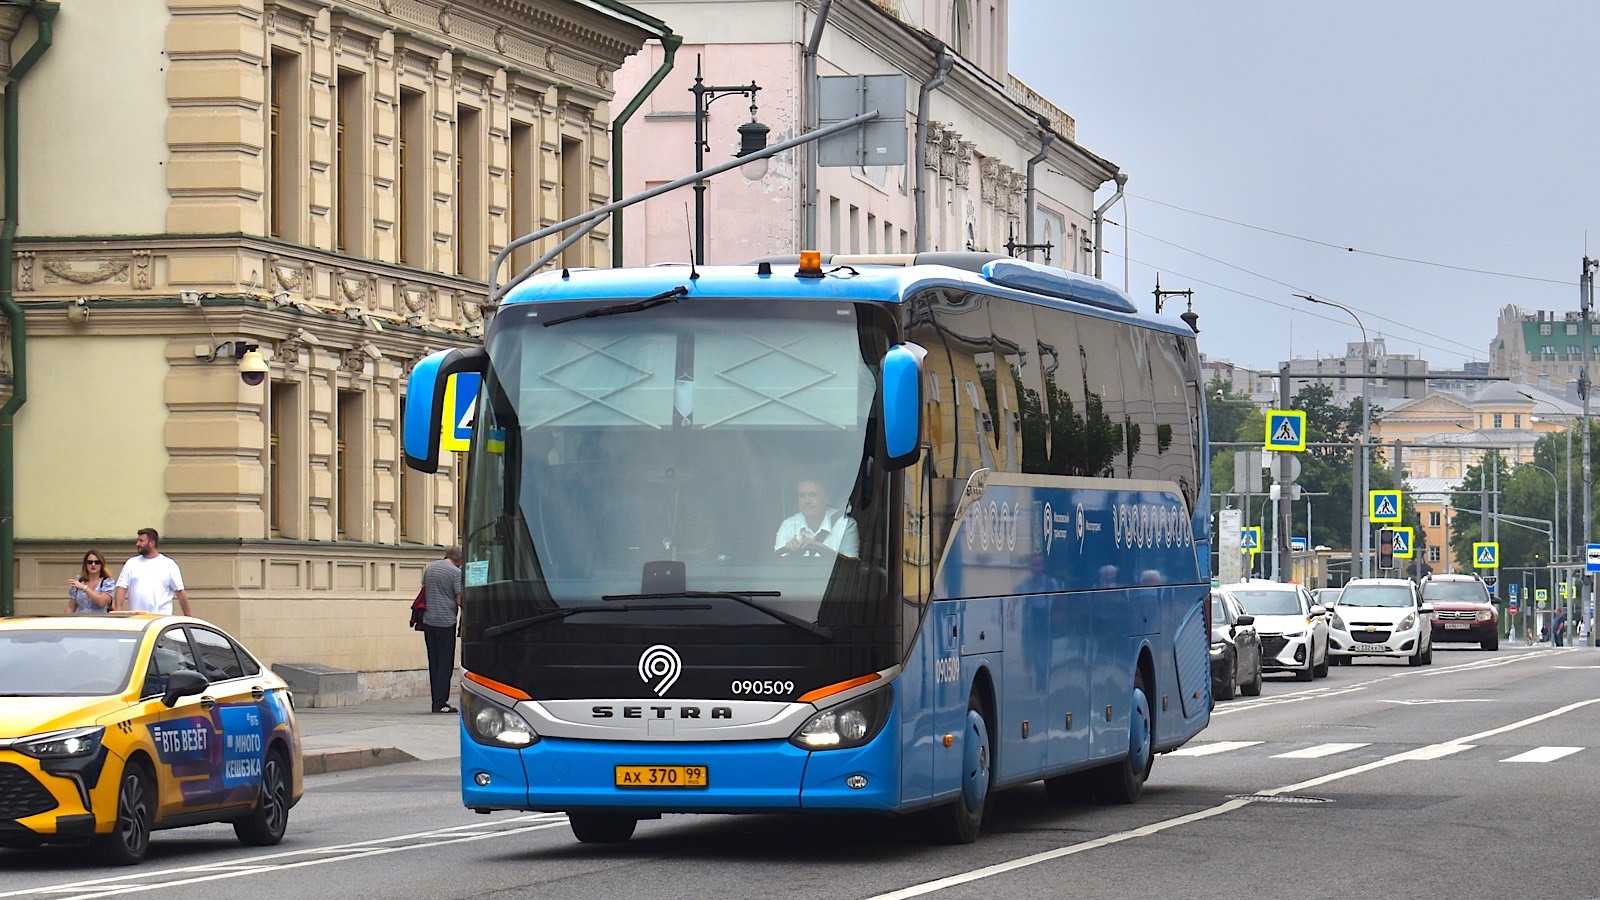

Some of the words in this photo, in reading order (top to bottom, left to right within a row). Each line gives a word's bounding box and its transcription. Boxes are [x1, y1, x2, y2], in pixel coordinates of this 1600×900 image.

[936, 656, 960, 683] 090509
[731, 680, 795, 695] 090509
[592, 706, 733, 719] SETRA
[162, 730, 180, 752] ВТБ
[181, 723, 207, 752] ВЕЗЁТ
[235, 733, 261, 753] МНОГО
[225, 758, 262, 779] КЕШБЭКА
[648, 768, 677, 783] 370
[686, 768, 701, 779] 99
